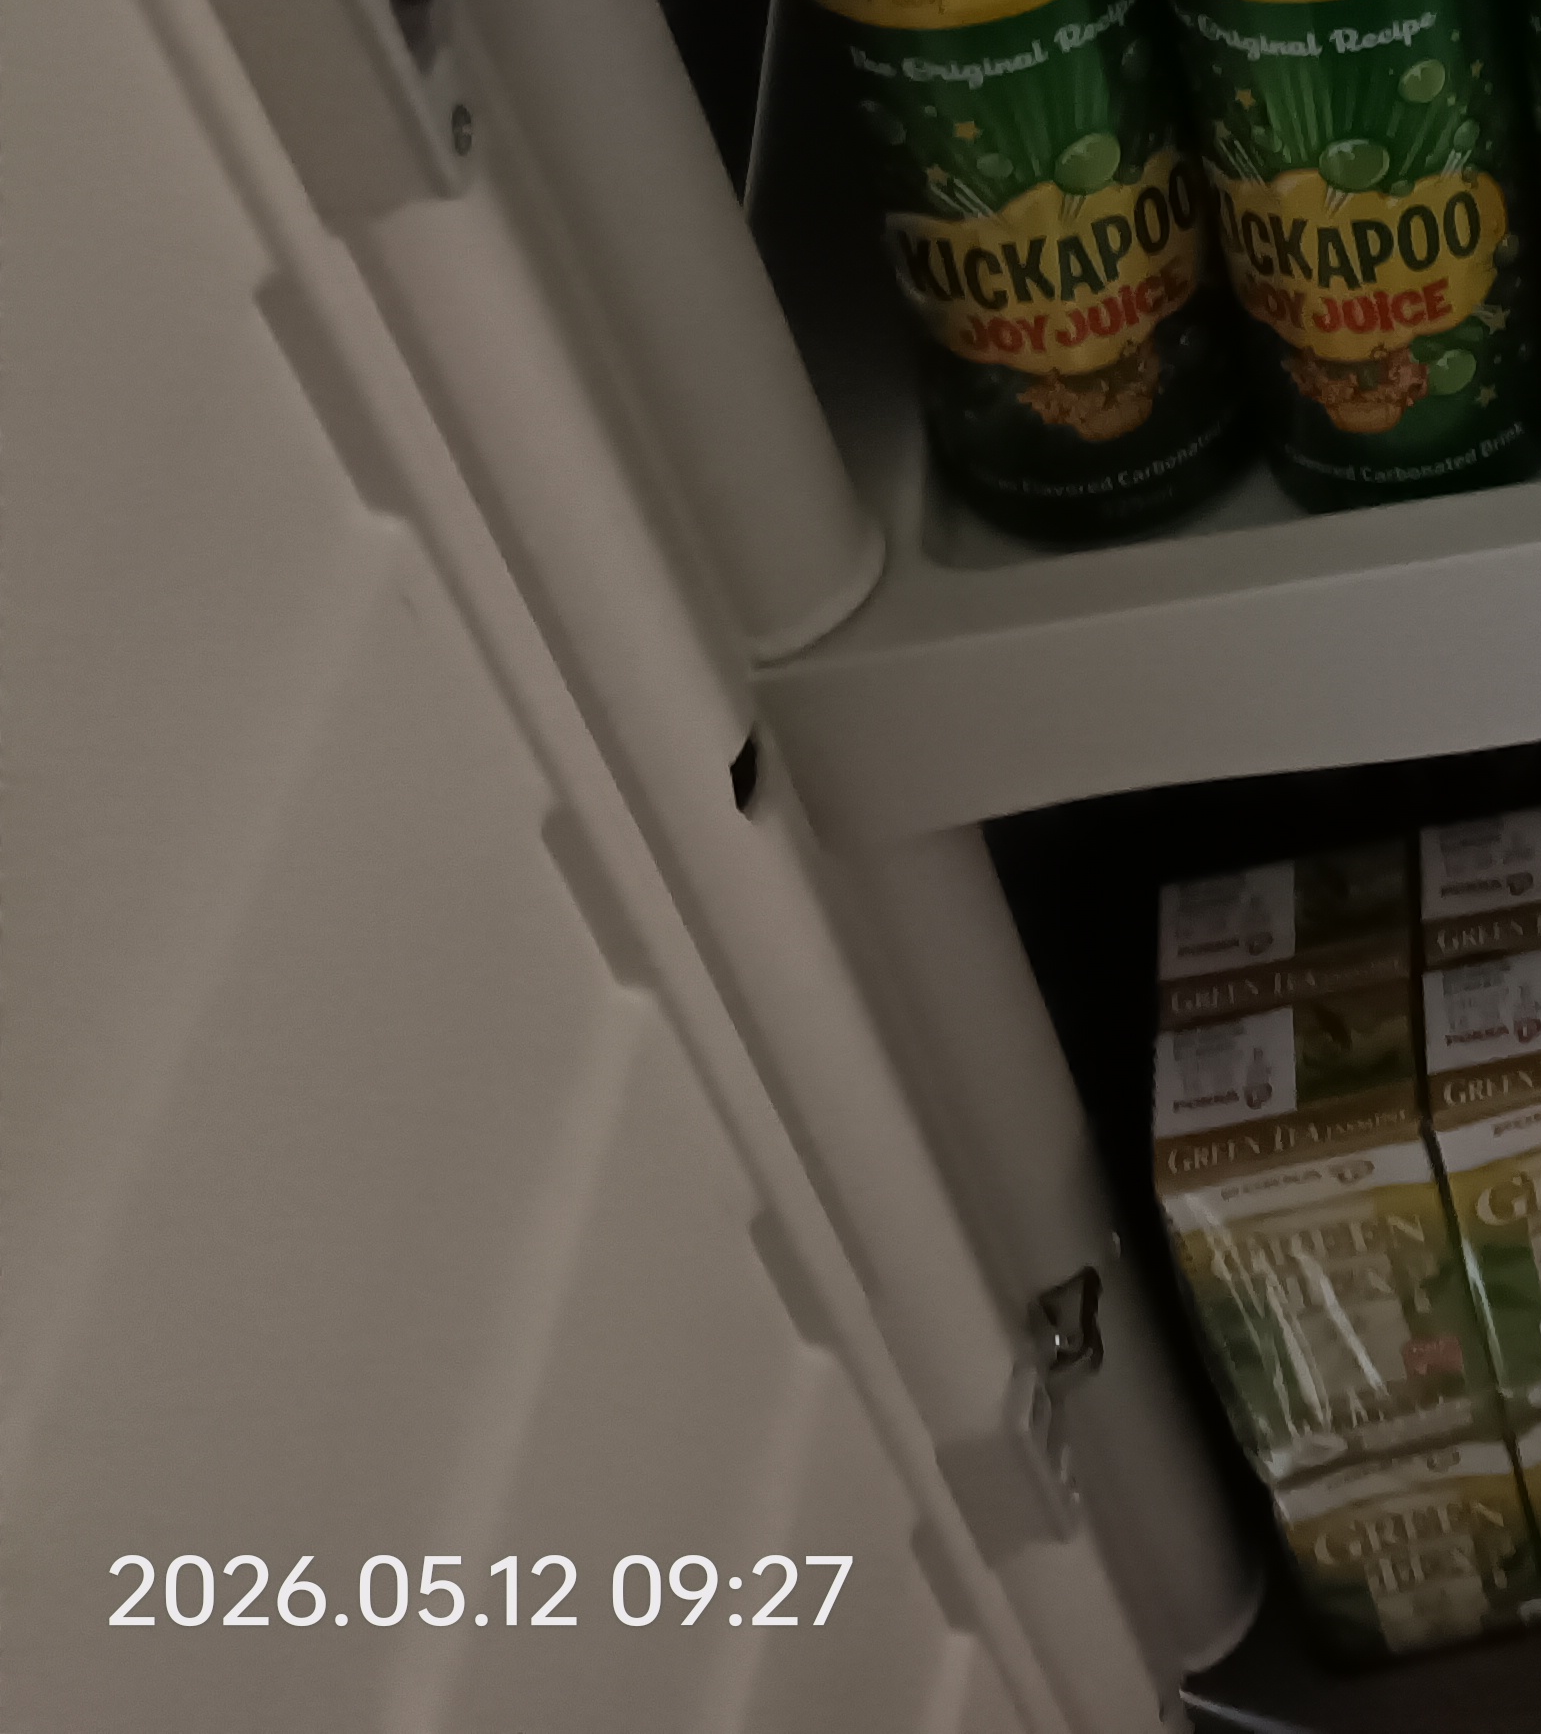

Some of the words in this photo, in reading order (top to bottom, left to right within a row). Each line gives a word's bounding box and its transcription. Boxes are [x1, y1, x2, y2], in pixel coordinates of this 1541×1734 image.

[1330, 11, 1437, 55] Recipe
[901, 165, 1197, 309] KICKAPOO
[1312, 277, 1454, 333] JUICE
[960, 315, 1048, 352] JOY
